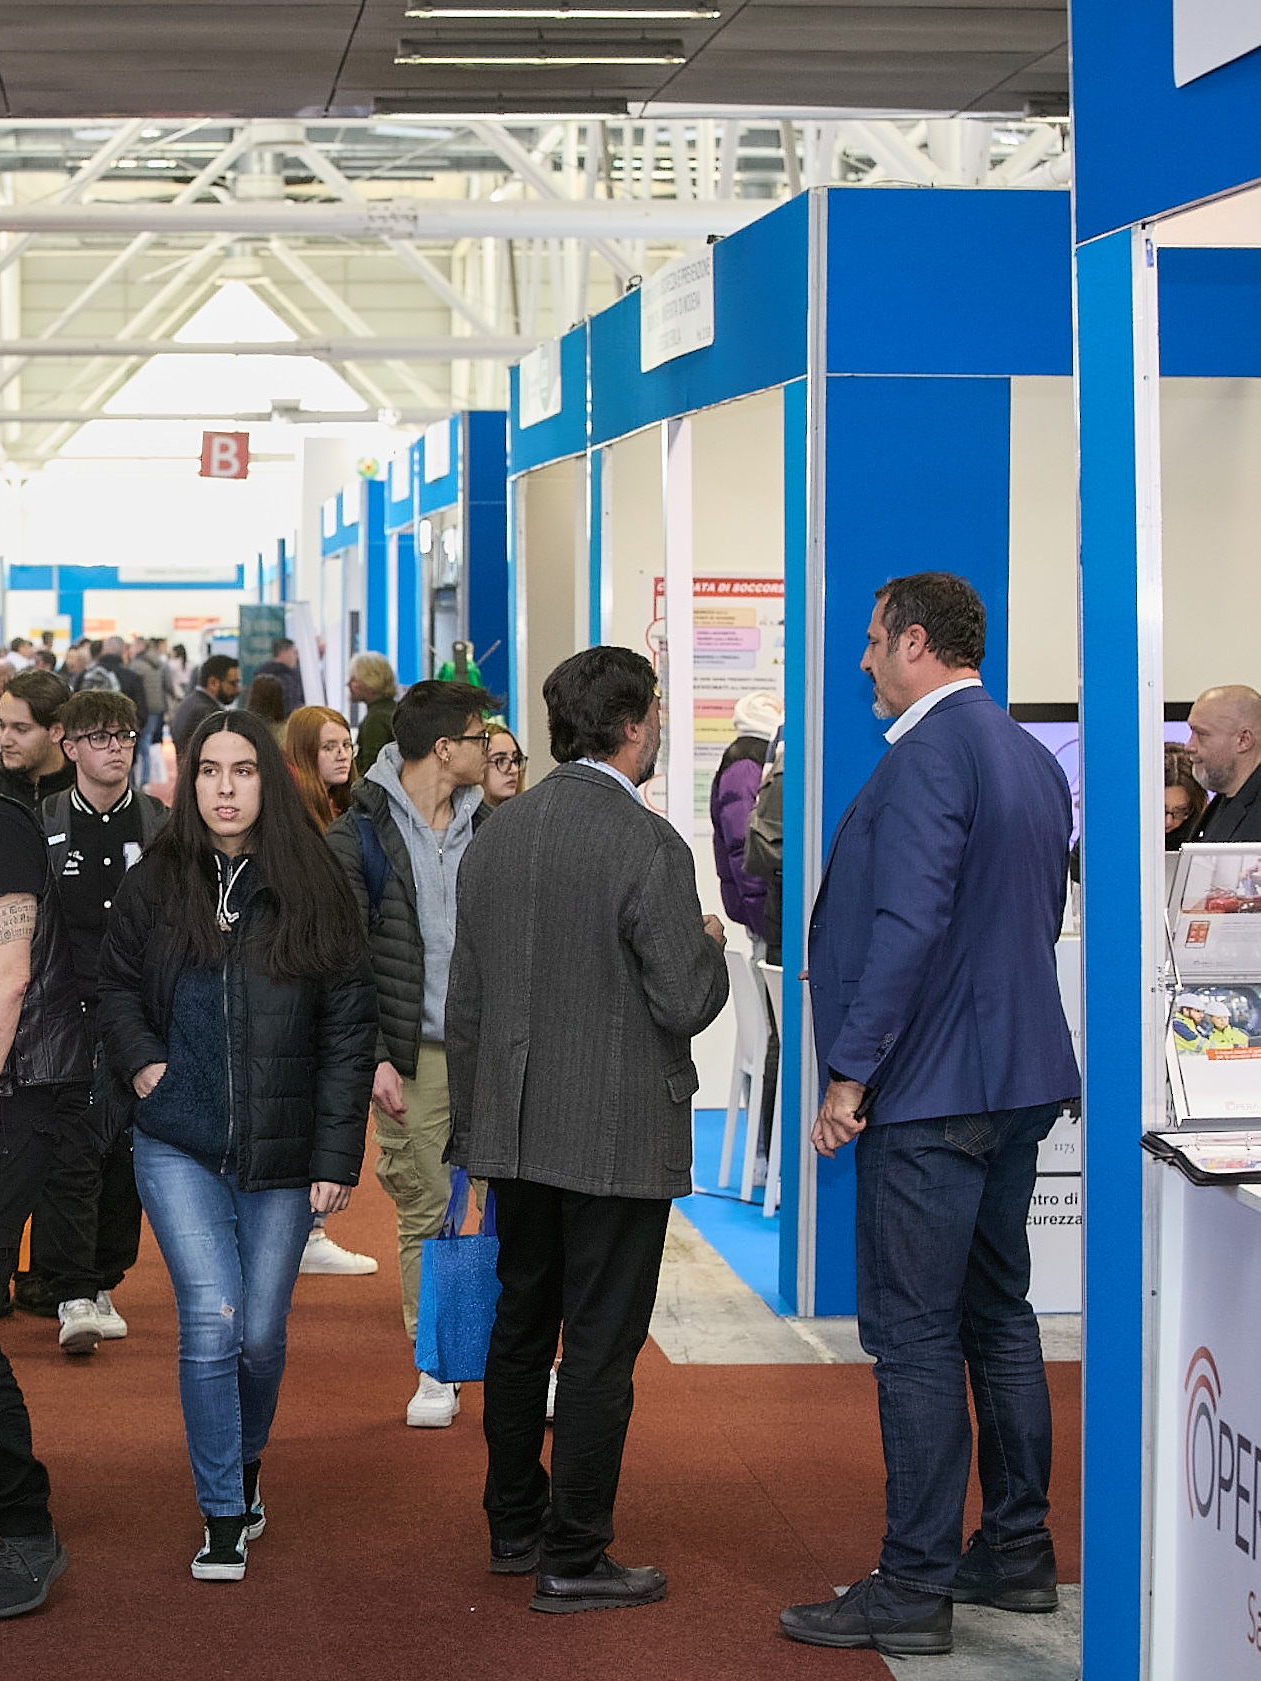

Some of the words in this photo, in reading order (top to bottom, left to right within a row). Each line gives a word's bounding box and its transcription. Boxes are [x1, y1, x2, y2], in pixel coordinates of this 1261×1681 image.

[212, 437, 239, 477] B
[1054, 1143, 1075, 1154] 1175
[1064, 1192, 1078, 1205] di
